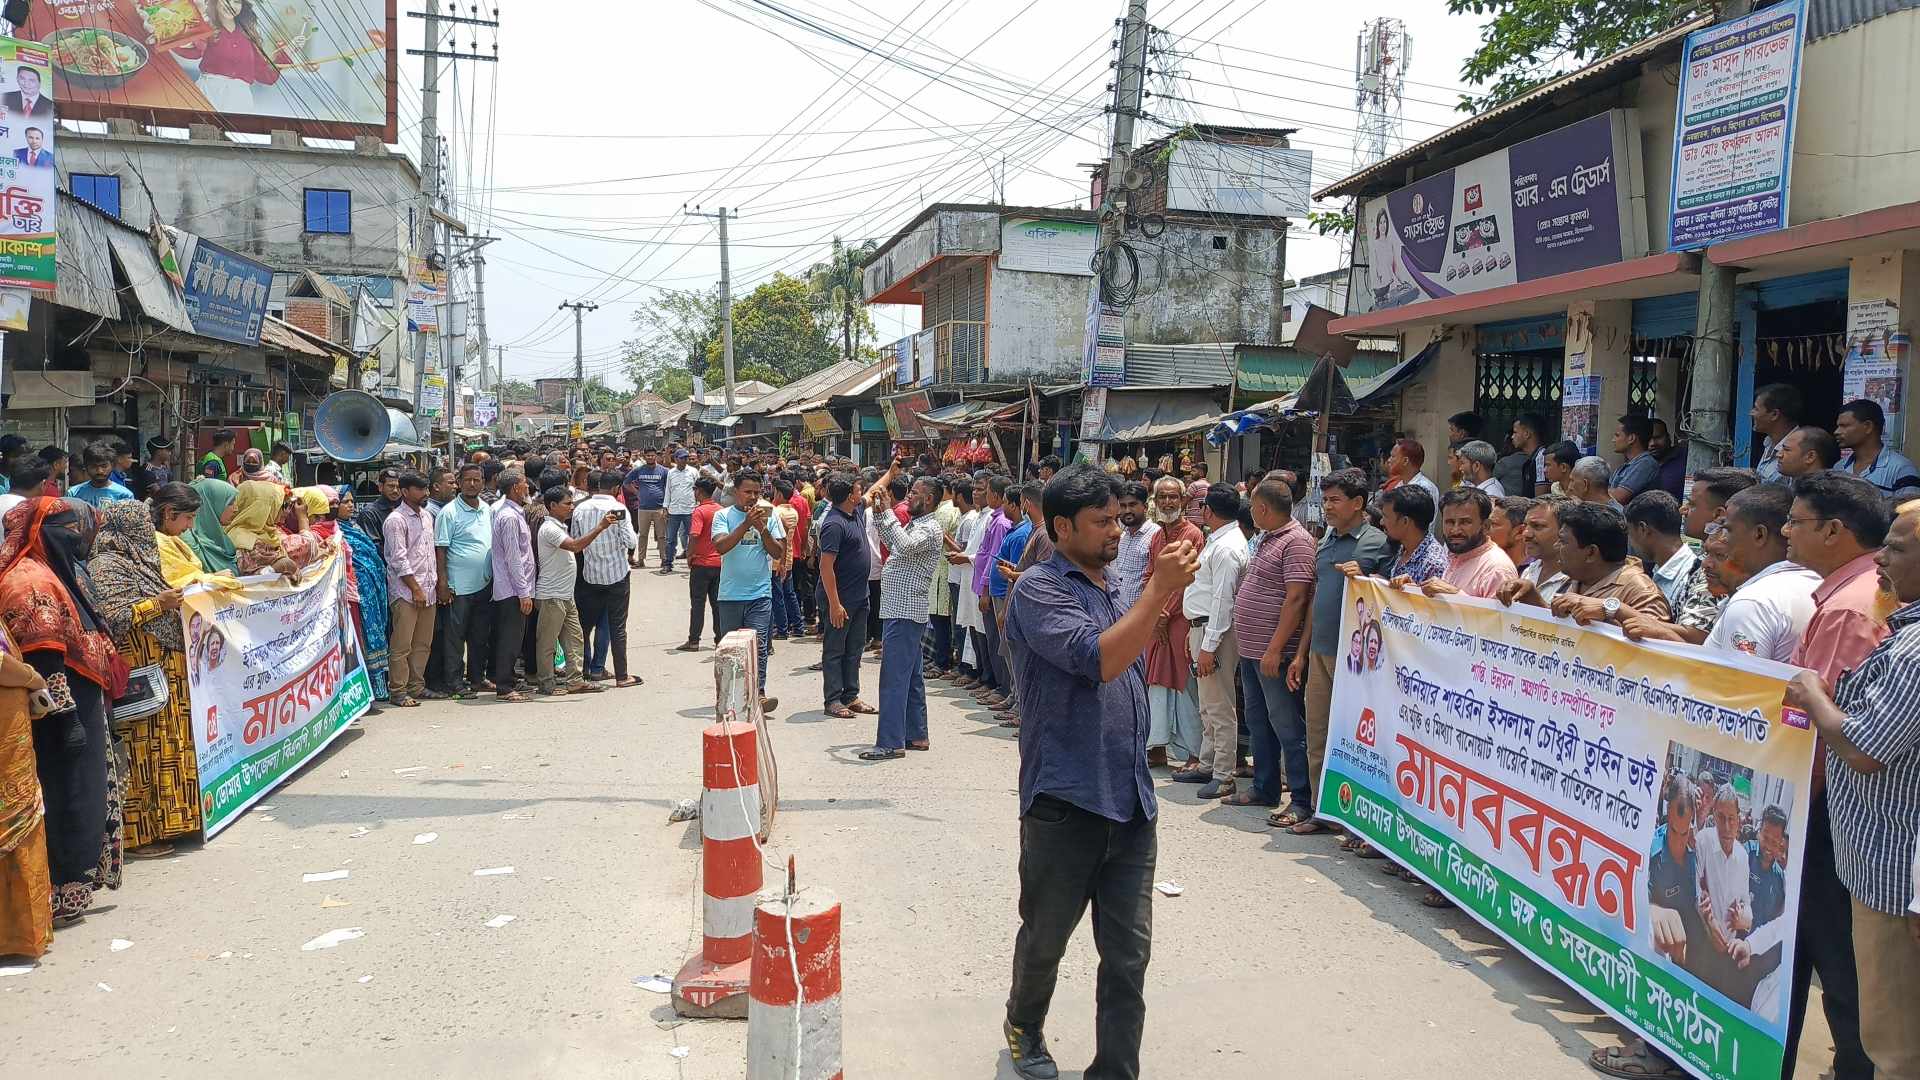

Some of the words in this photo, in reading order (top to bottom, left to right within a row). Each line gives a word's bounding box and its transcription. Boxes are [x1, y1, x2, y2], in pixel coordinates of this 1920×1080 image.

[1692, 63, 1709, 80] ডাঃ
[1712, 51, 1740, 73] মাসুদ
[1744, 38, 1789, 64] পারভেজ
[1684, 147, 1698, 162] ডাঃ
[1700, 142, 1718, 158] মোঃ
[1754, 125, 1781, 143] আলম
[1548, 176, 1567, 198] এন
[1571, 156, 1610, 195] ট্রেডার্স
[12, 215, 42, 232] চাই
[1404, 222, 1423, 240] গ্যাস
[1423, 214, 1445, 234] স্টোভ
[1413, 623, 1423, 637] ০১
[1423, 624, 1477, 656] (ডোমার-ডিমলা)
[1480, 638, 1509, 661] আসনের
[1510, 646, 1537, 670] সাবেক
[1538, 650, 1560, 676] এমপি
[1561, 663, 1569, 679] ও
[1572, 657, 1614, 695] নীলফামারী
[1615, 677, 1638, 703] জেলা
[1639, 676, 1679, 714] বিএনপির
[1680, 695, 1715, 726] সাবেক
[1716, 707, 1769, 742] সভাপতি
[1520, 677, 1550, 704] অগ্রগতি
[1551, 690, 1559, 706] ও
[1560, 687, 1599, 720] সম্প্রীতির
[1599, 704, 1616, 730] দূত
[1359, 718, 1375, 742] ০৪
[1395, 666, 1440, 708] ইঞ্জিনিয়ার
[1442, 688, 1484, 724] শাহরিন
[1487, 696, 1535, 744] ইসলাম
[1537, 716, 1580, 763] চৌধুরী
[1583, 736, 1624, 783] তুহিন
[1628, 753, 1658, 798] ভাই
[216, 771, 242, 809] ডোমার
[240, 749, 281, 787] উপজেলা
[282, 726, 311, 767] বিএনপি,
[1408, 703, 1423, 732] মুক্তি
[1424, 717, 1431, 734] ও
[1432, 712, 1453, 746] মিথ্যা
[1455, 727, 1494, 760] বানোয়াট
[1496, 746, 1529, 778] গায়েবি
[1531, 757, 1558, 792] মামলা
[1560, 768, 1604, 813] বাতিলের
[1605, 789, 1642, 830] দাবিতে
[1395, 734, 1643, 932] মানববন্ধন
[1355, 794, 1393, 837] ডোমার
[1395, 808, 1443, 870] উপজেলা
[1445, 843, 1503, 920] বিএনপি,
[1509, 889, 1537, 937] অঙ্গ
[1540, 915, 1553, 947] ও
[1557, 923, 1640, 1002] সহযোগী
[1645, 974, 1723, 1065] সংগঠন
